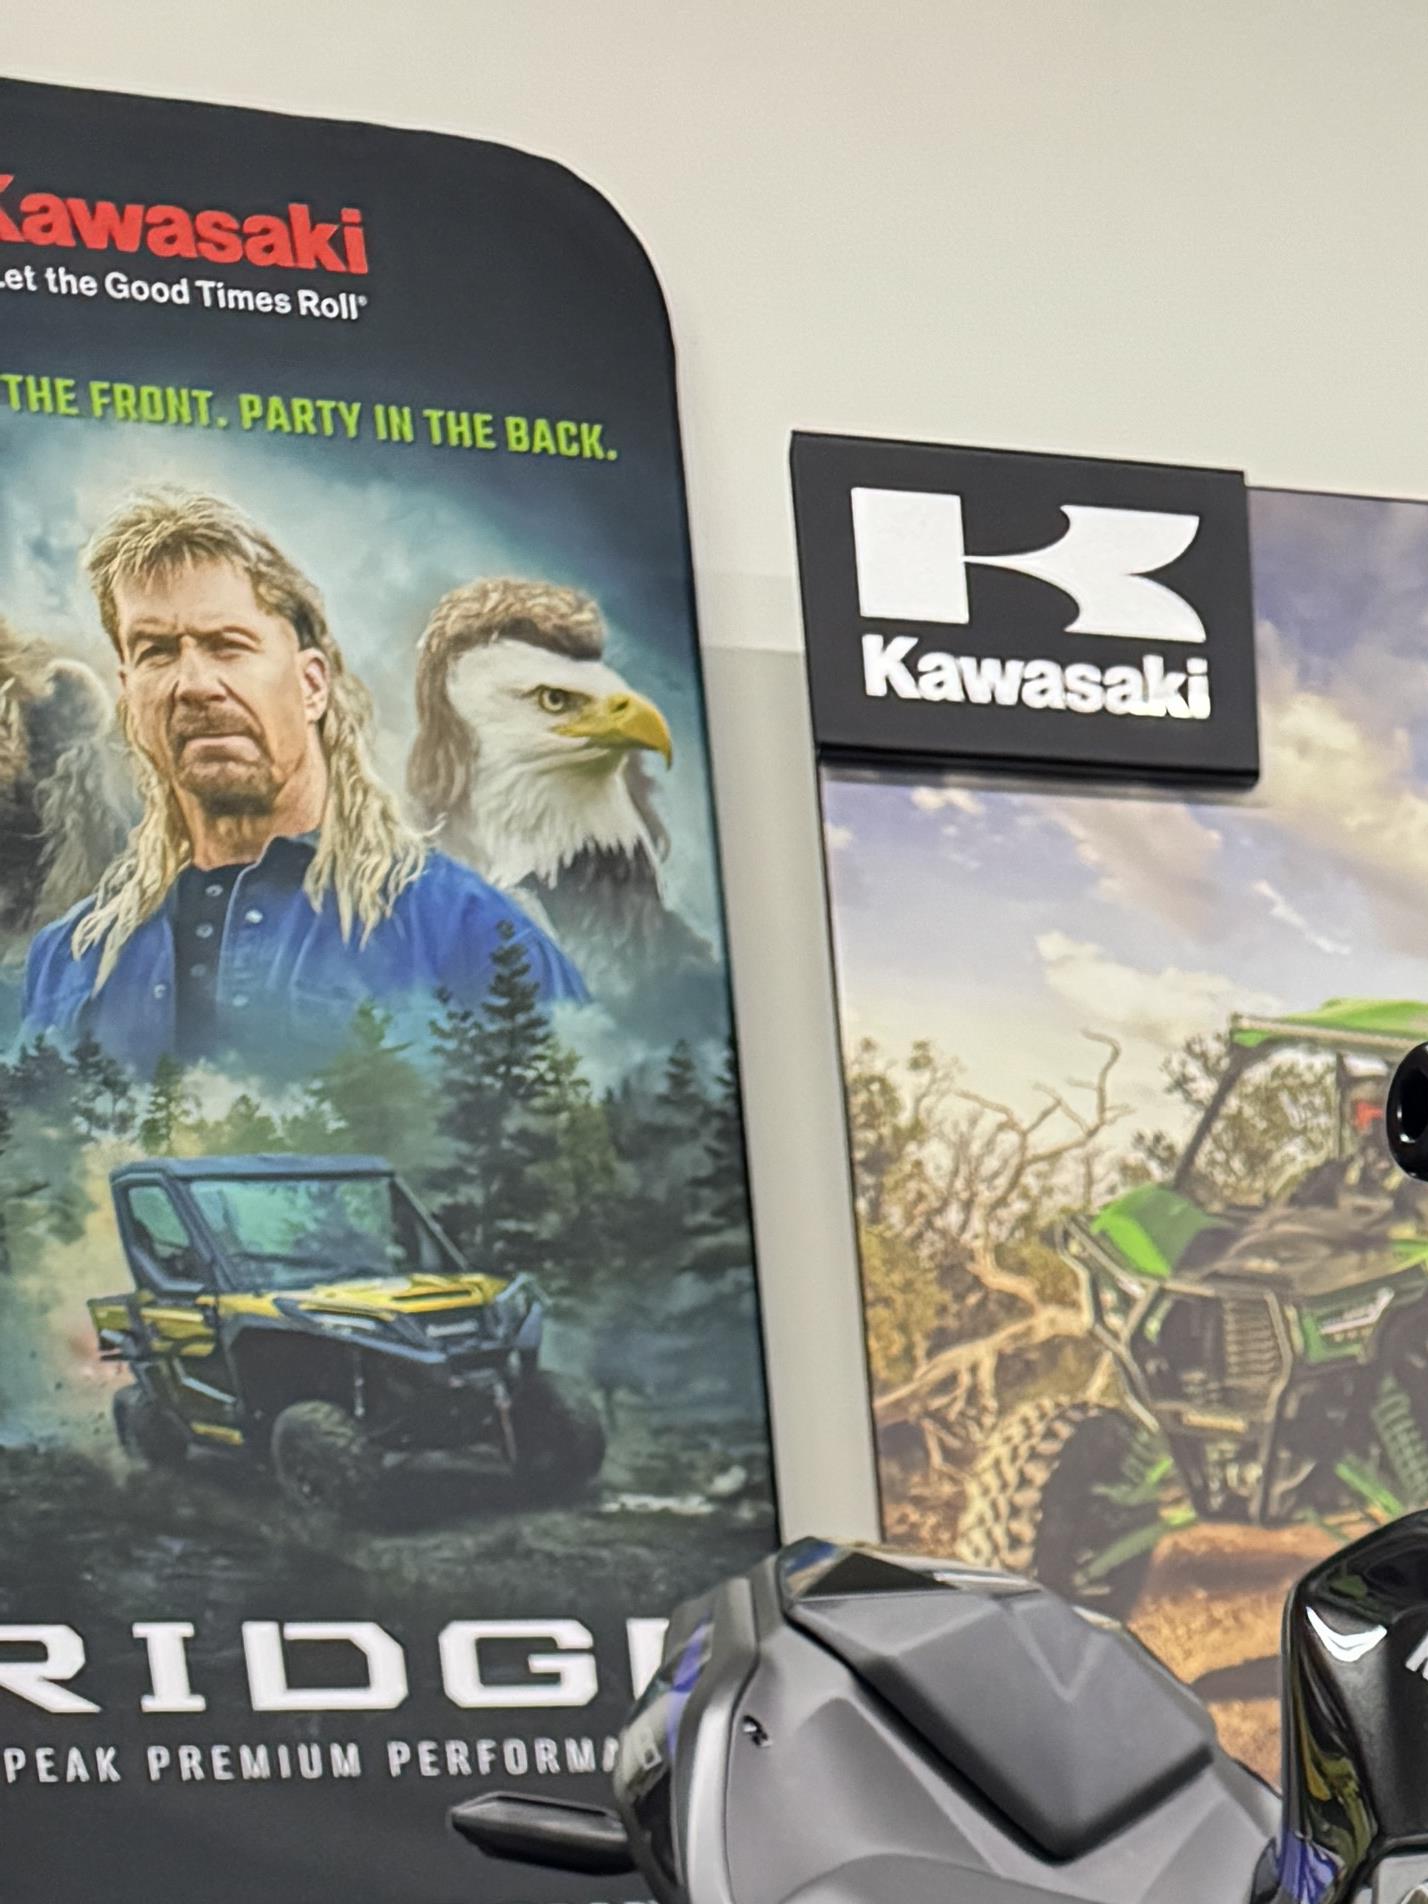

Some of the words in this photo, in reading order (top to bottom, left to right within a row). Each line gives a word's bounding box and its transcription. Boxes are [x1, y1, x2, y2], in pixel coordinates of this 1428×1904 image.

[0, 265, 37, 292] et
[45, 267, 98, 297] the
[105, 271, 190, 305] Good
[196, 279, 292, 315] Times
[0, 374, 80, 416] THE
[89, 380, 229, 428] FRONT.
[238, 393, 361, 439] PARTY
[373, 403, 415, 443] IN
[422, 408, 498, 450] THE
[504, 415, 619, 461] BACK.
[860, 633, 1212, 721] Kawasaki
[0, 1617, 668, 1714] RIDG
[4, 1744, 122, 1784] PEAK
[147, 1740, 362, 1782] PREMIUM
